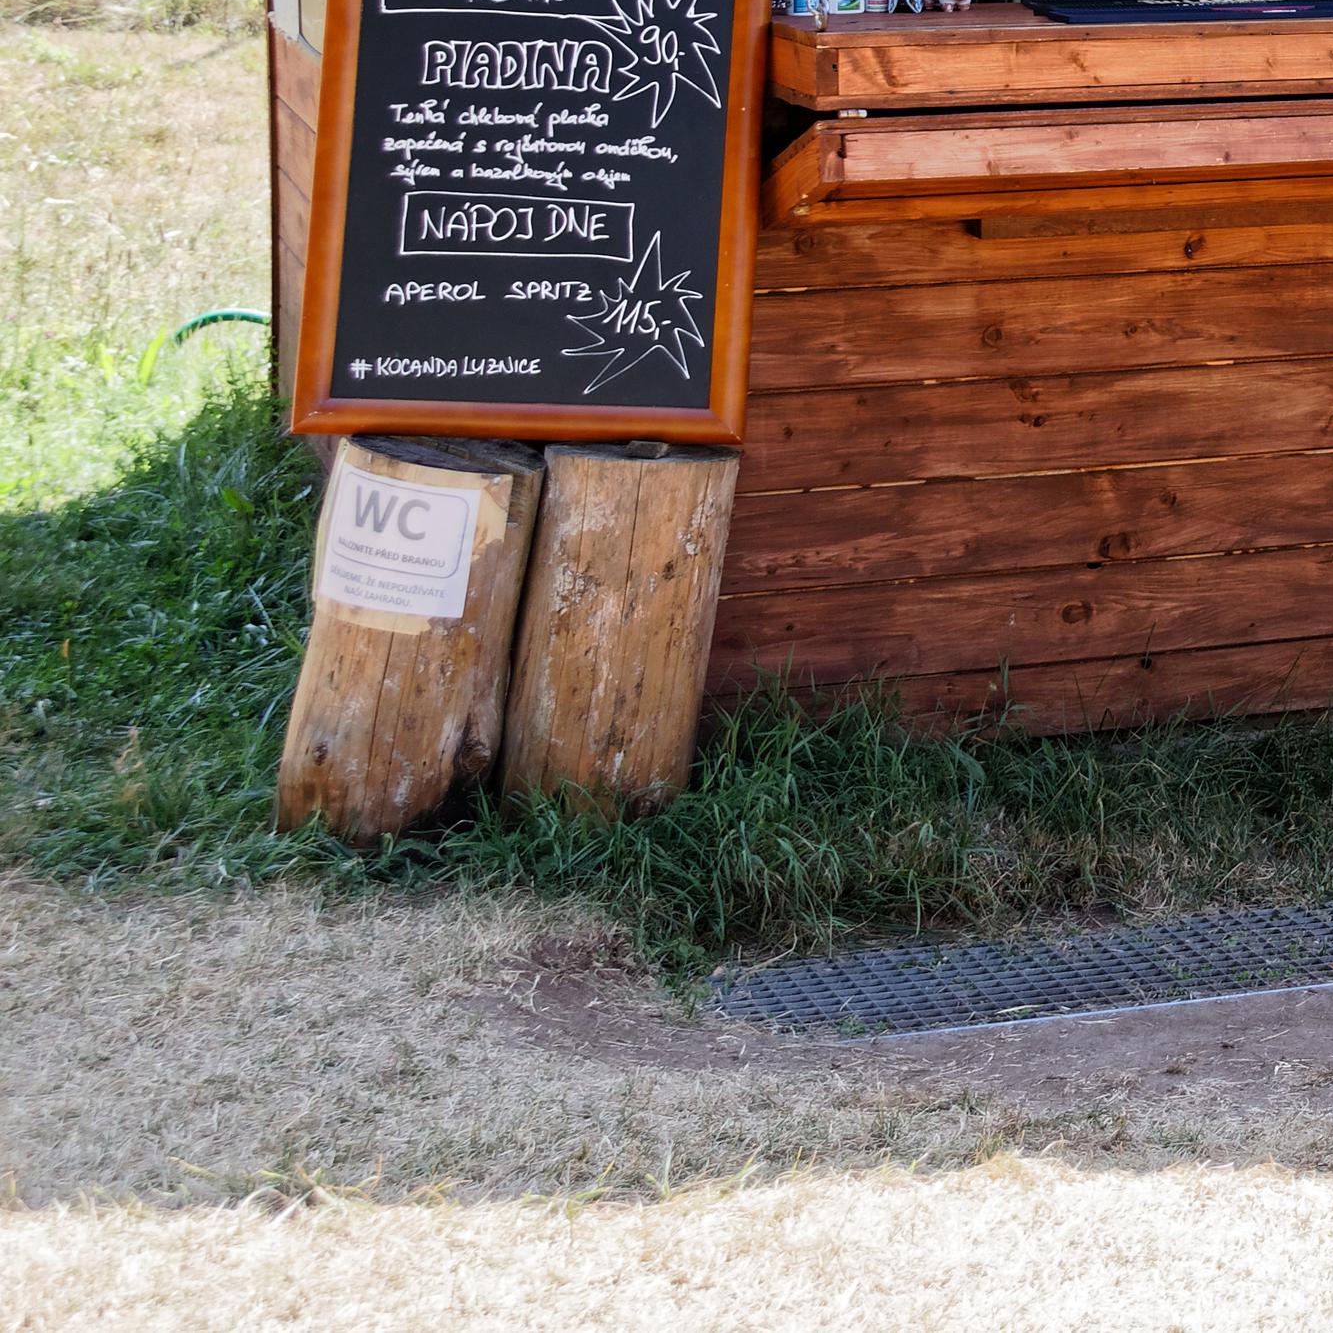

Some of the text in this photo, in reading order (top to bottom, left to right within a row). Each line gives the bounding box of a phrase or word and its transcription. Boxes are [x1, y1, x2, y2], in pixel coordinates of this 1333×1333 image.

[421, 38, 613, 93] PIADINA
[388, 98, 609, 137] Tenká chlebová placka
[382, 132, 466, 159] zapečená
[473, 139, 487, 153] s
[451, 168, 464, 179] a
[421, 202, 610, 242] NÁPOJ DNE
[384, 280, 594, 305] APEROL SPRITZ
[602, 300, 672, 341] 115,-
[353, 484, 431, 541] WC
